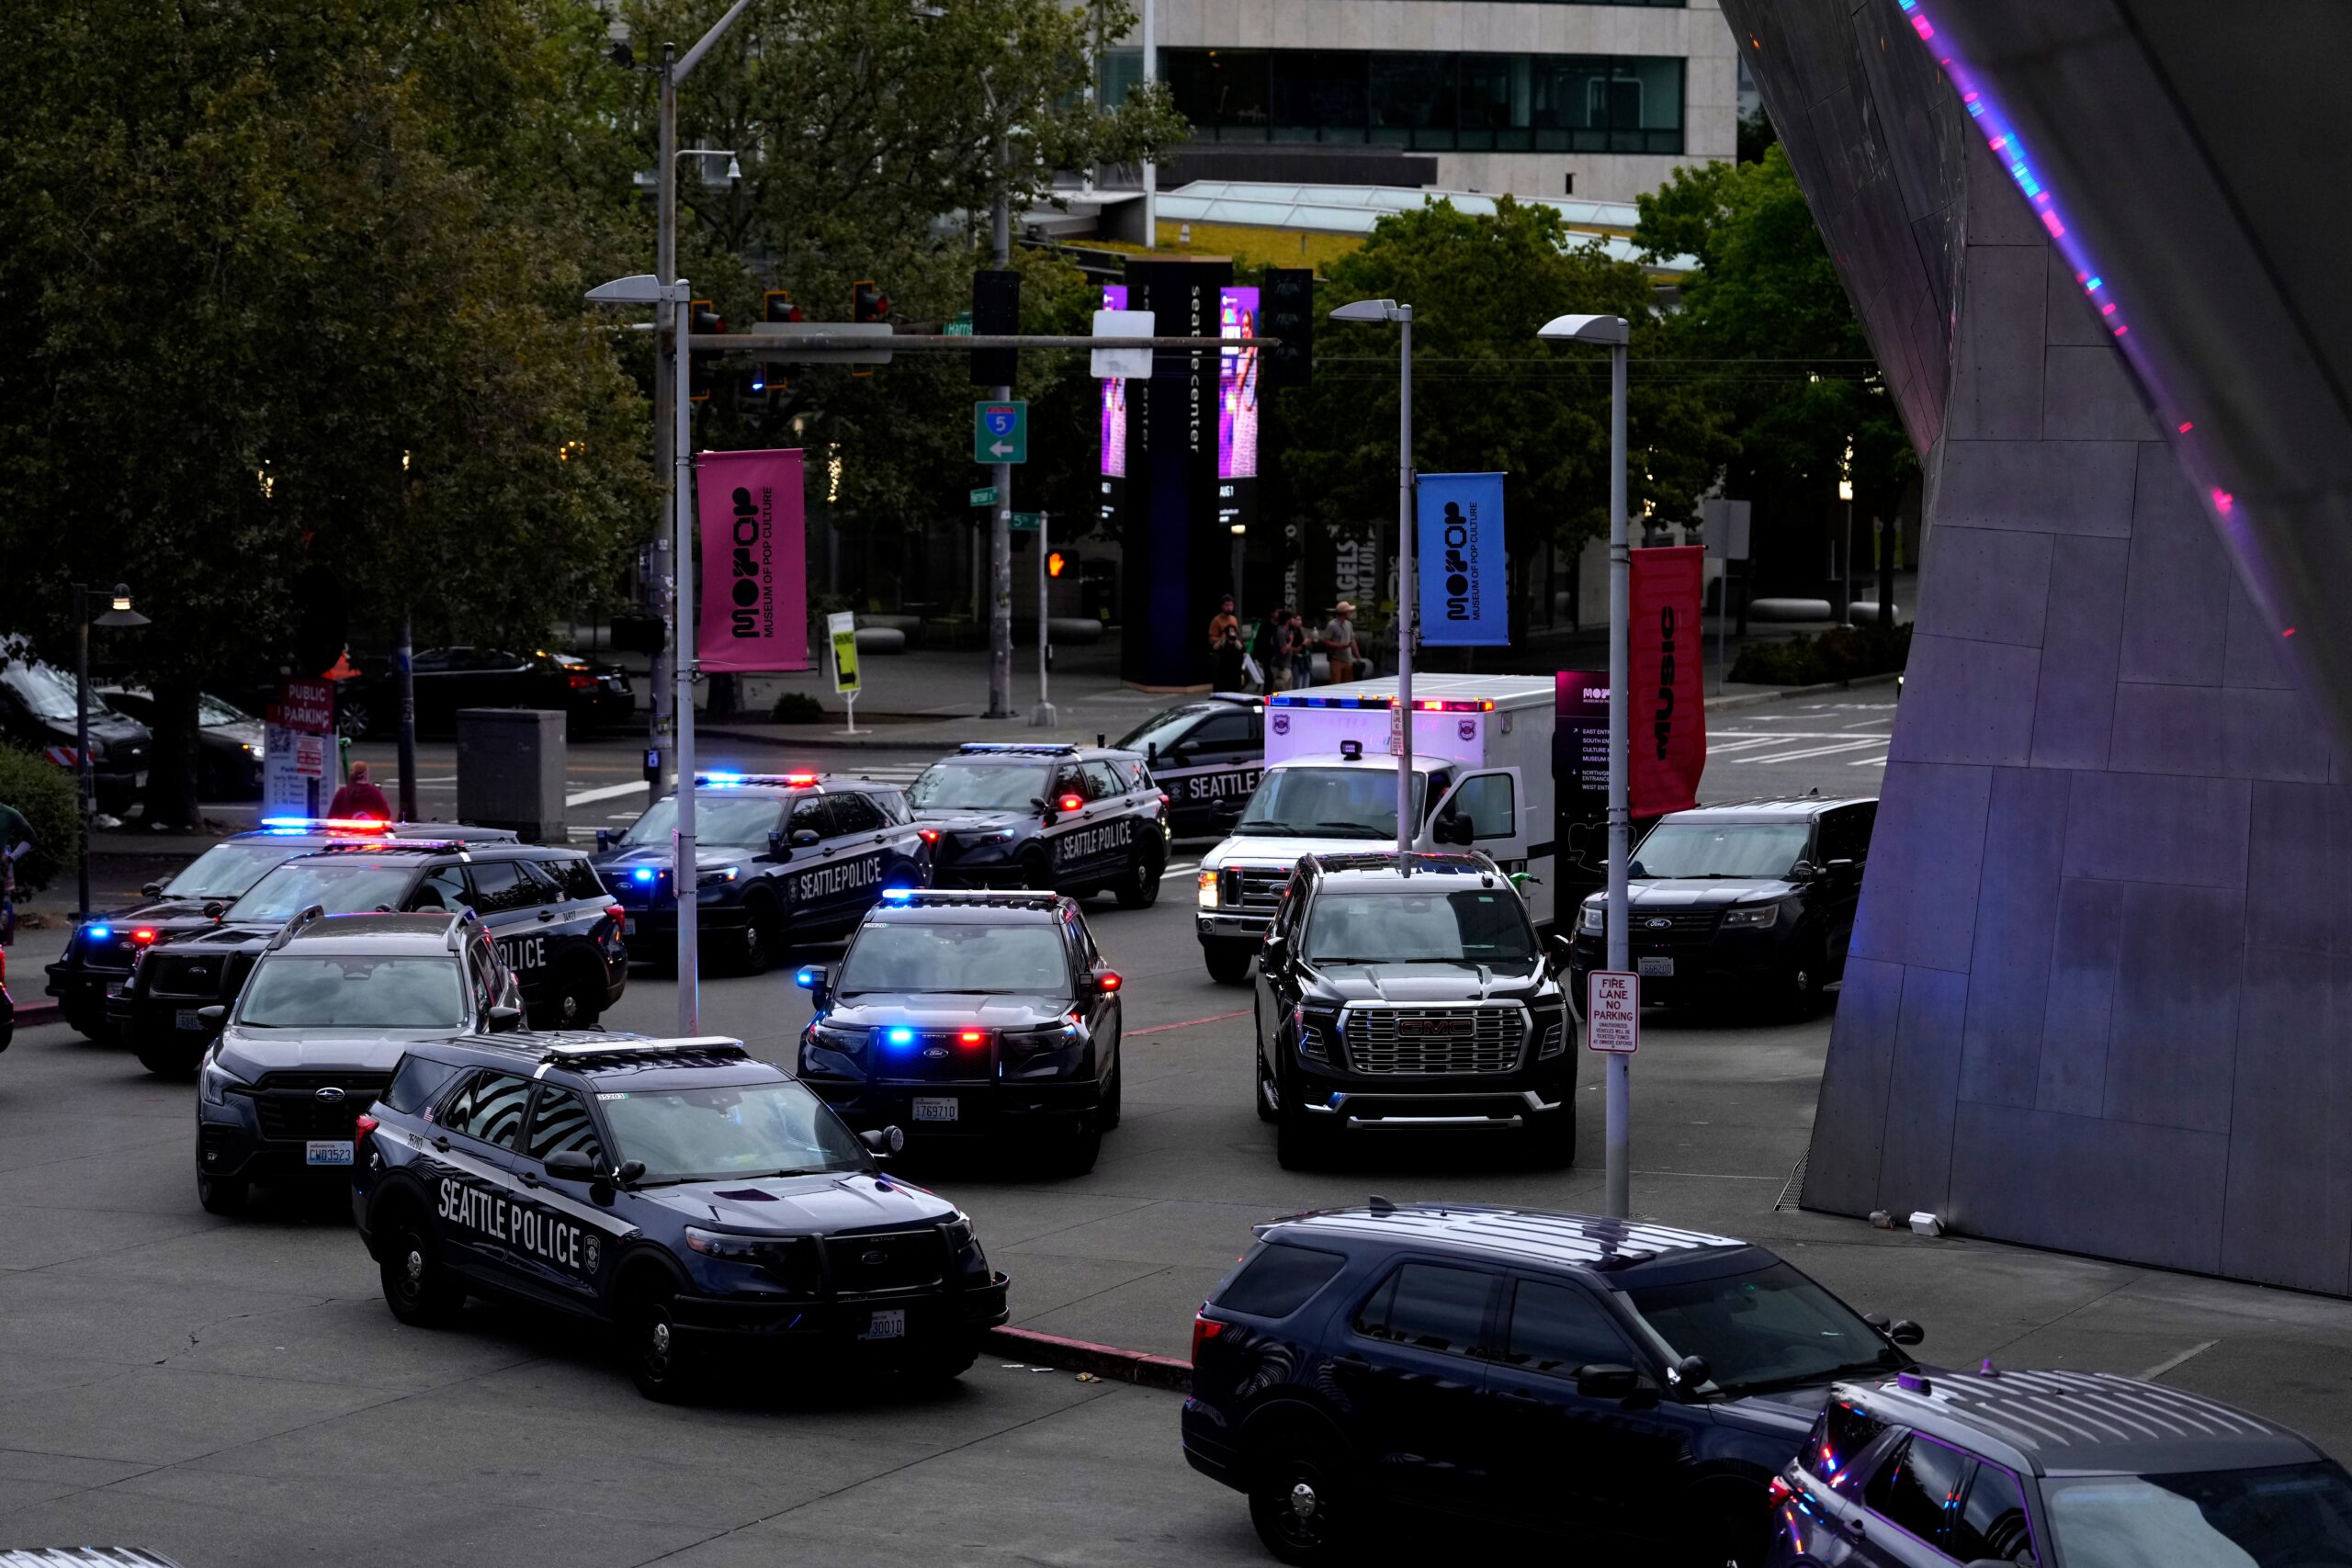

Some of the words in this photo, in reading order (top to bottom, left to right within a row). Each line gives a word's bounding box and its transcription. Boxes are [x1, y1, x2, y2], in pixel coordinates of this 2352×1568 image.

[995, 416, 1006, 431] 5
[763, 486, 773, 540] CULTURE
[1469, 502, 1477, 543] CULTURE
[763, 542, 773, 566] POP
[1470, 545, 1478, 564] POP
[763, 569, 773, 585] OF
[1336, 539, 1358, 601] AGELS
[1471, 566, 1479, 579] OF
[1472, 580, 1480, 620] MUSEUM
[763, 587, 774, 637] MUSEUM
[288, 683, 326, 702] PUBLIC
[1583, 688, 1610, 699] MOP
[1655, 605, 1675, 761] MUSIC
[284, 705, 329, 728] PARKING
[1189, 770, 1256, 800] SEATTLE
[1064, 829, 1097, 860] SEATTLE
[1098, 820, 1132, 852] POLICE
[800, 867, 841, 900] SEATTLE
[841, 856, 882, 890] POLICE
[500, 937, 547, 972] OLICE
[1600, 989, 1628, 999] LANE
[1602, 978, 1625, 988] FIRE
[1593, 1010, 1633, 1021] PARKING
[1606, 1000, 1621, 1010] NO
[1400, 1021, 1471, 1034] GMC
[438, 1177, 505, 1238] SEATTLE
[511, 1204, 581, 1269] POLICE
